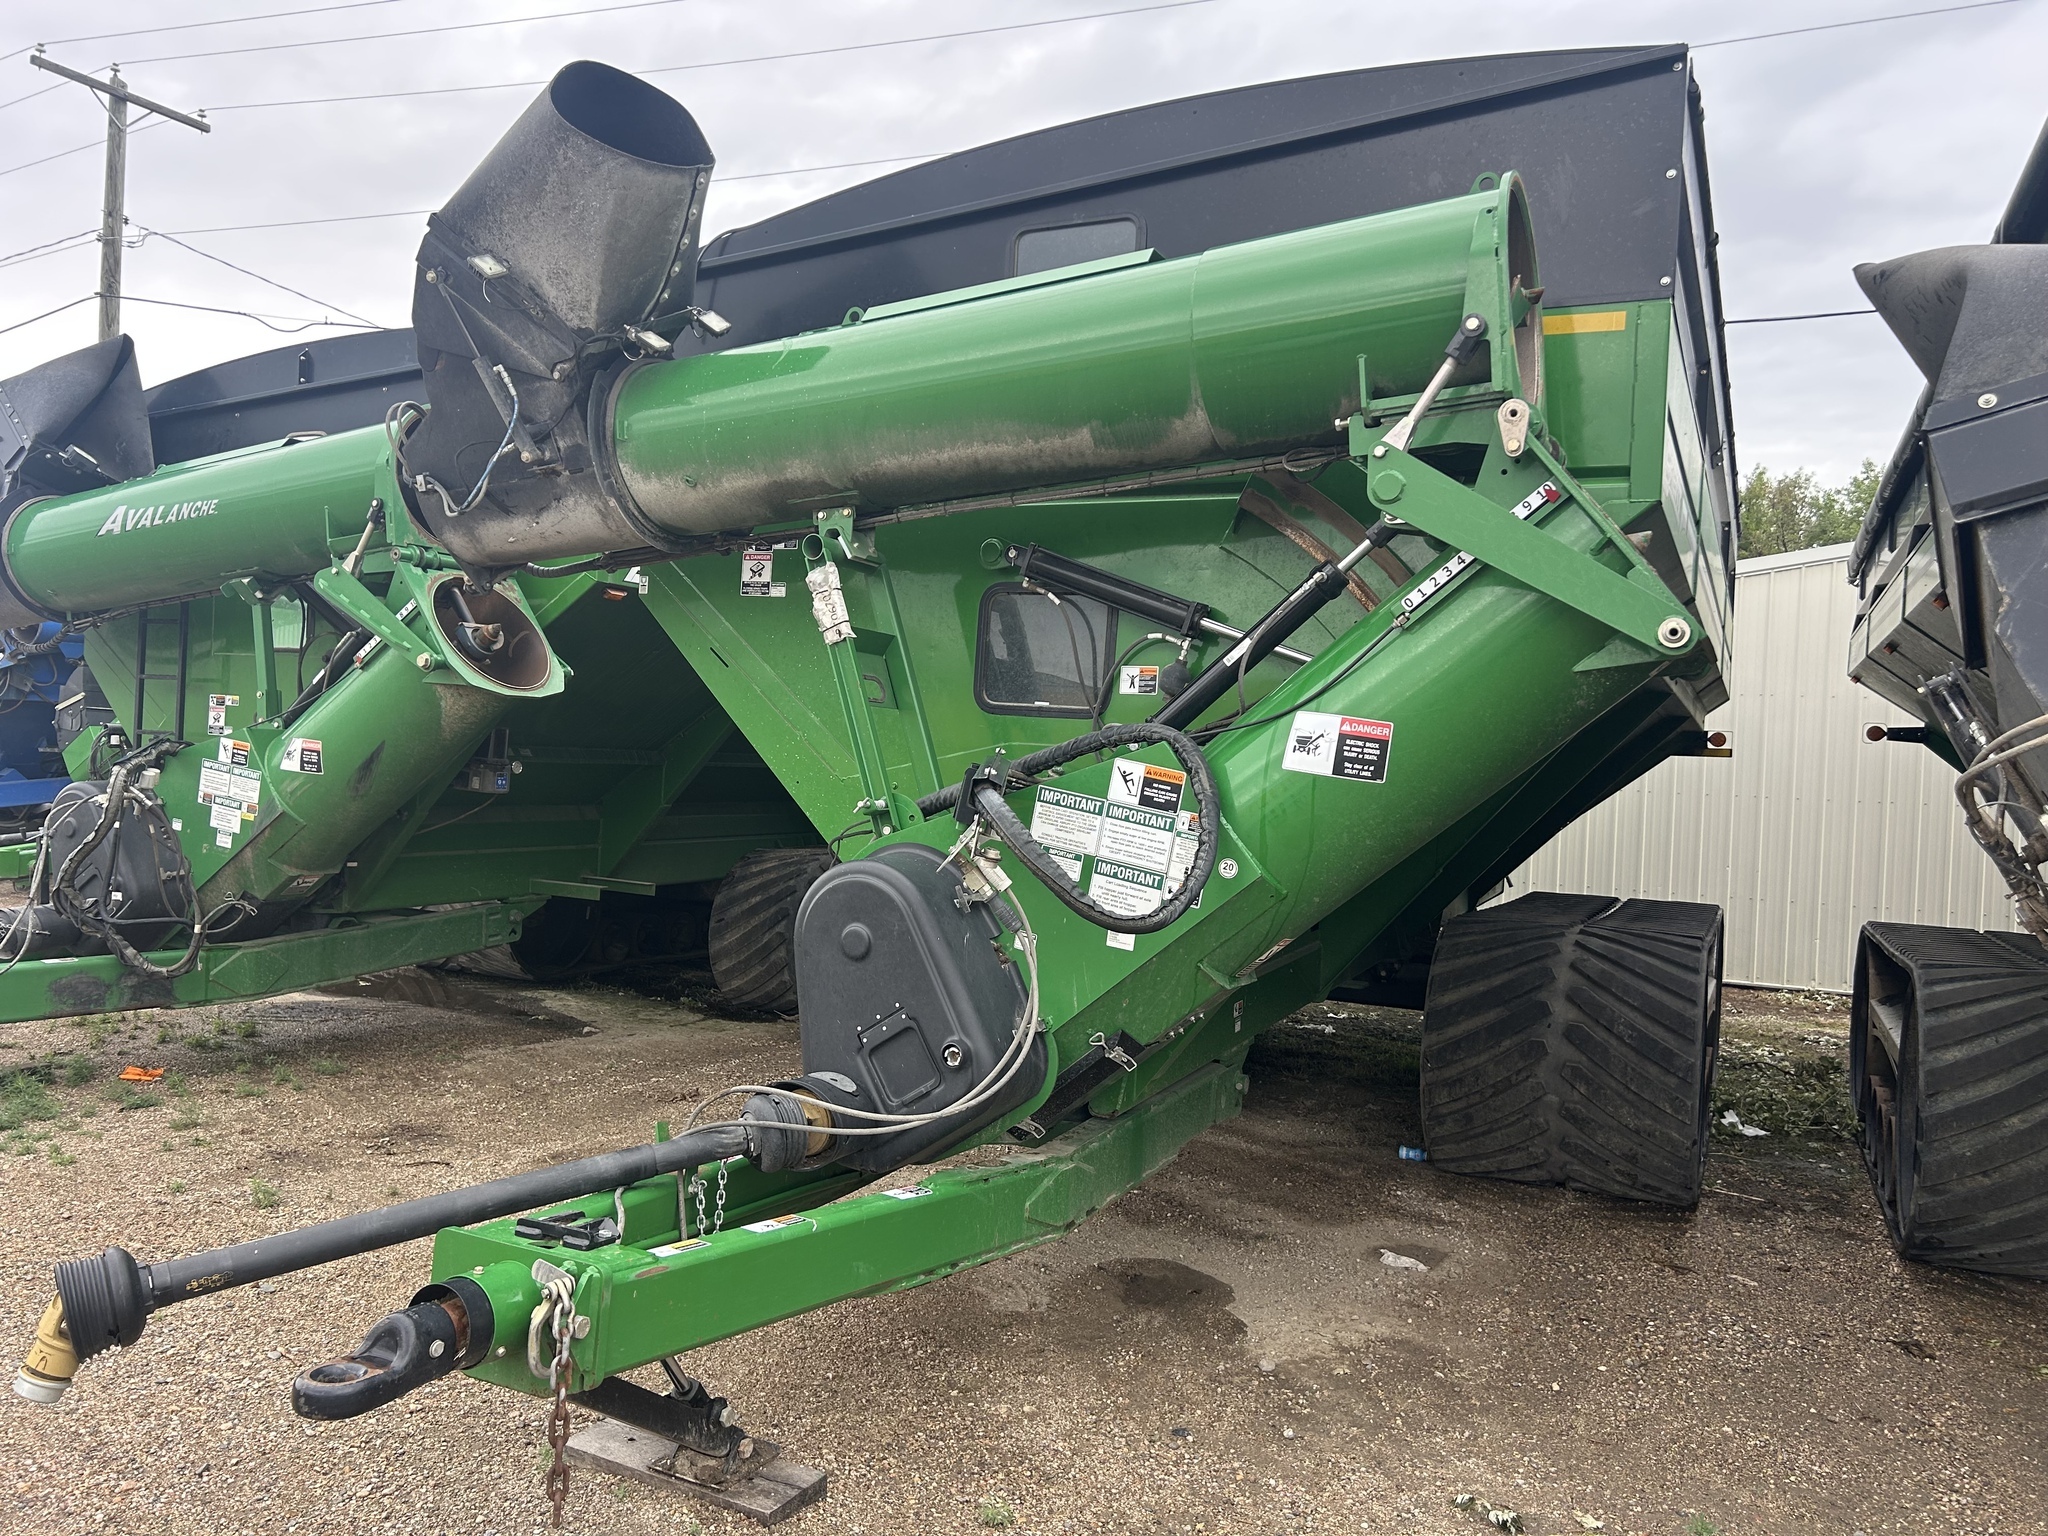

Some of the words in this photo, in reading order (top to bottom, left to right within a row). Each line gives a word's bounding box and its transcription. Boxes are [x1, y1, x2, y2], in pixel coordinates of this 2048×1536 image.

[1522, 500, 1532, 512] 9
[96, 499, 219, 537] AVALANCHE
[1404, 597, 1414, 609] 0
[1416, 588, 1428, 598] 1
[1428, 576, 1441, 588] 2
[1442, 566, 1453, 578] 3
[1456, 554, 1467, 566] 4
[1351, 723, 1390, 736] DANGER
[204, 761, 230, 772] IMPORTANT
[232, 768, 260, 780] IMPORTANT
[1152, 770, 1183, 782] WARNING
[215, 796, 240, 808] IMPORTANT
[1040, 788, 1102, 814] IMPORTANT
[1108, 805, 1172, 830] IMPORTANT
[1049, 848, 1076, 859] IMPORTANT
[1222, 862, 1234, 872] 20
[1097, 862, 1161, 887] IMPORTANT
